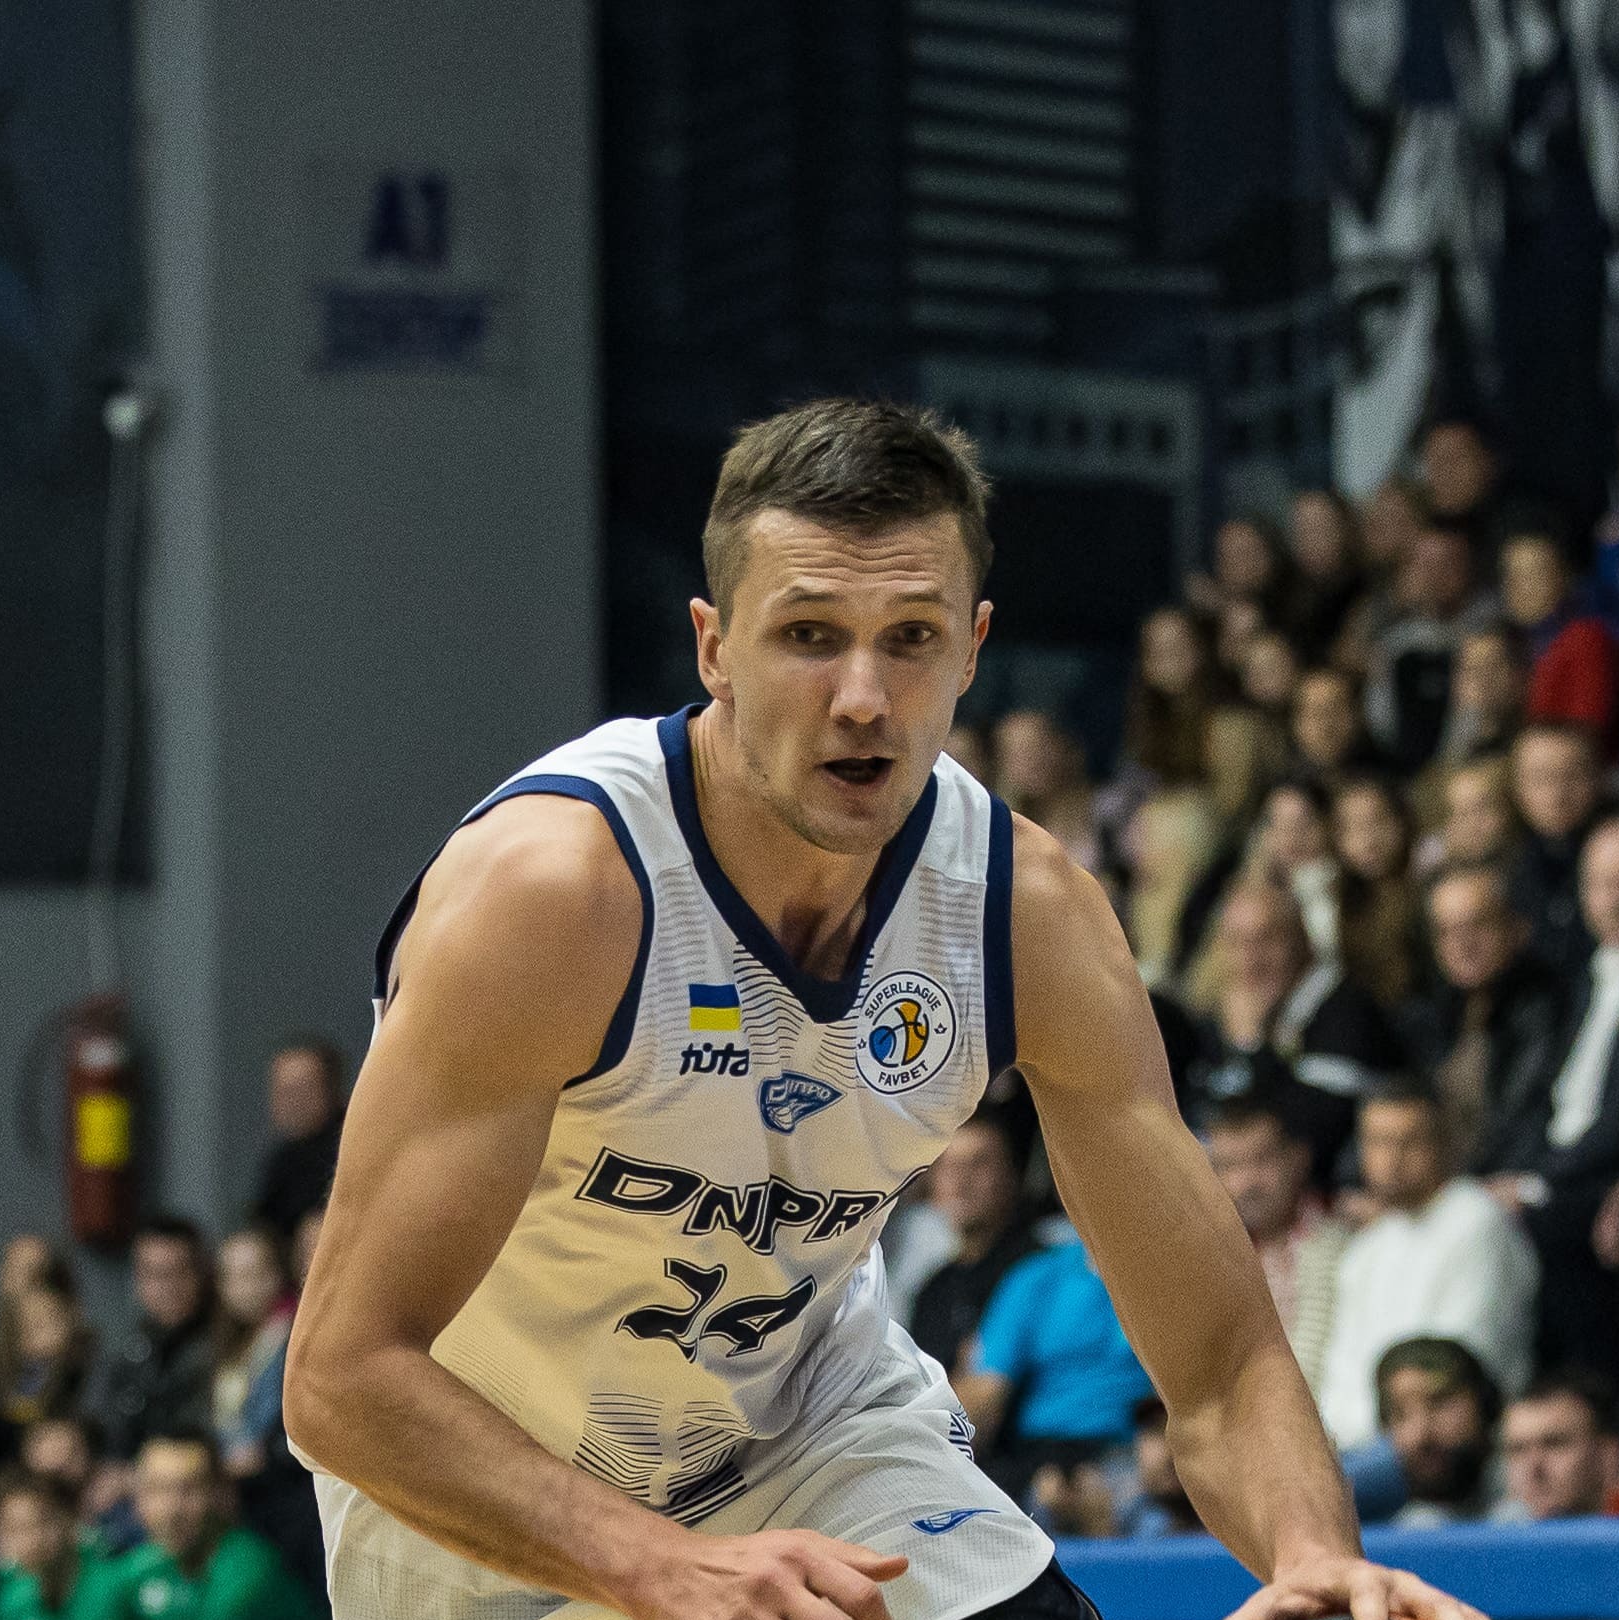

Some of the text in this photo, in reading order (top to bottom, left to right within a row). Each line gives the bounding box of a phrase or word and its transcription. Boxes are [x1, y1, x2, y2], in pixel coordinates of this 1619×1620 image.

[865, 982, 941, 1018] SUPERLEAGUE
[878, 1060, 928, 1086] FAVBET
[573, 1145, 929, 1256] DNPR
